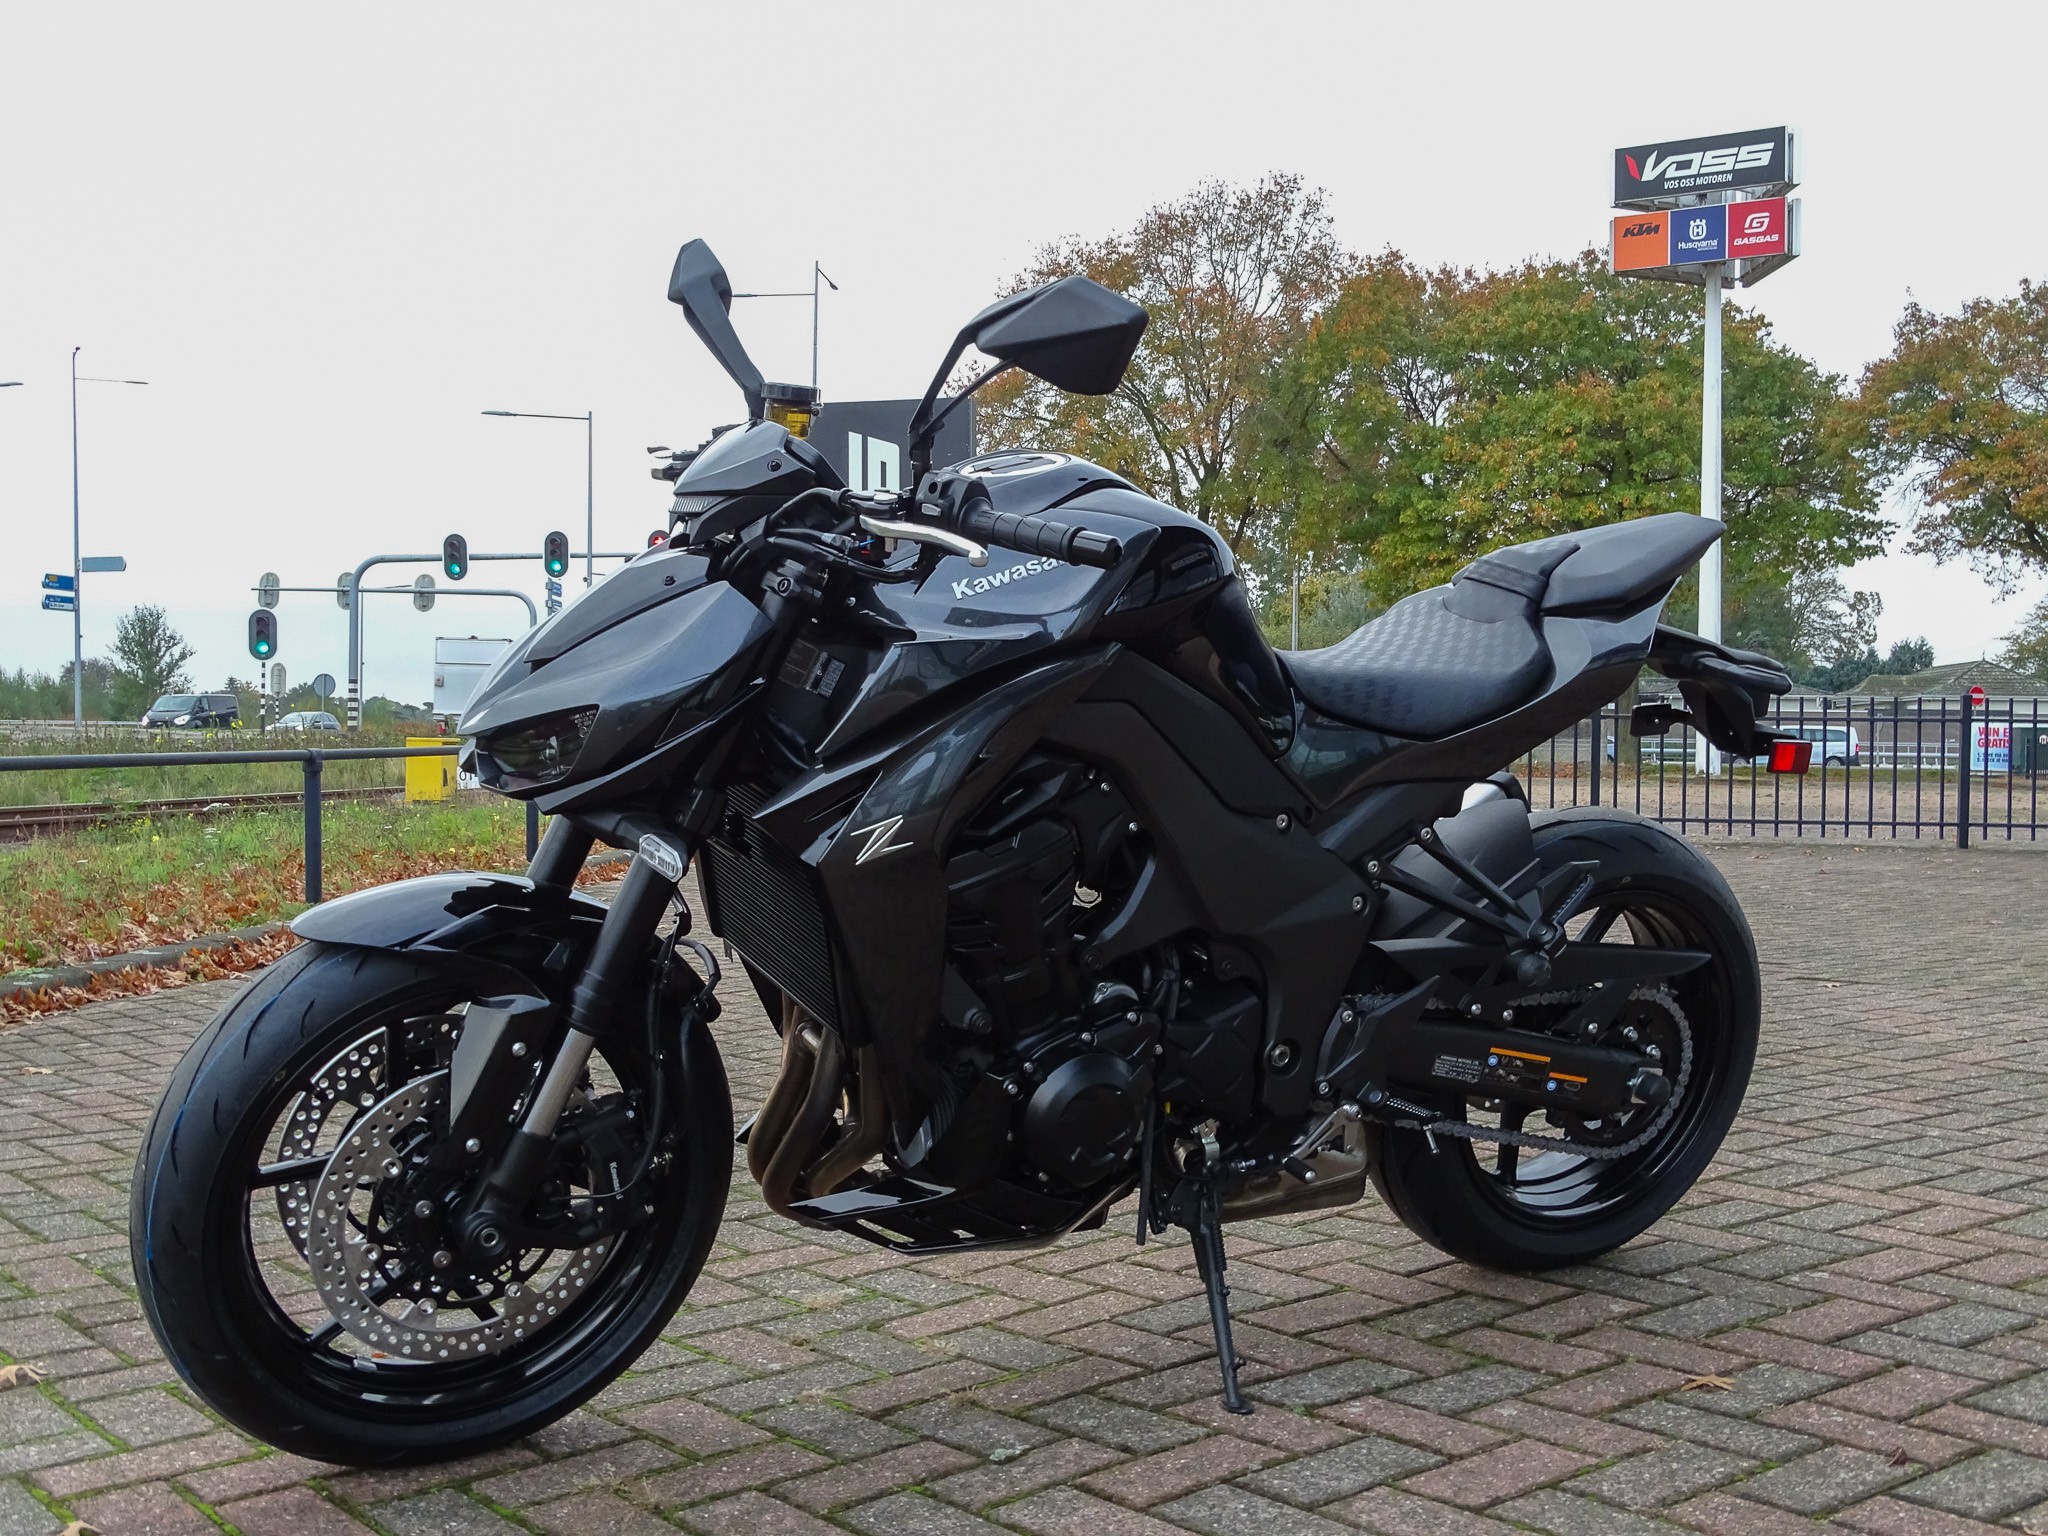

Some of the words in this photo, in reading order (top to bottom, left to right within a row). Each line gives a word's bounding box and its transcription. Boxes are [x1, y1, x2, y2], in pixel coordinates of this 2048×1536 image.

[1641, 142, 1775, 182] VOSS
[1664, 180, 1680, 190] VOS
[1680, 177, 1695, 188] OSS
[1695, 172, 1733, 186] MOTOREN
[1622, 222, 1660, 238] KTM
[1678, 239, 1718, 251] Husqvarna
[1733, 233, 1779, 246] GASGAS
[951, 556, 1066, 600] Kawasa
